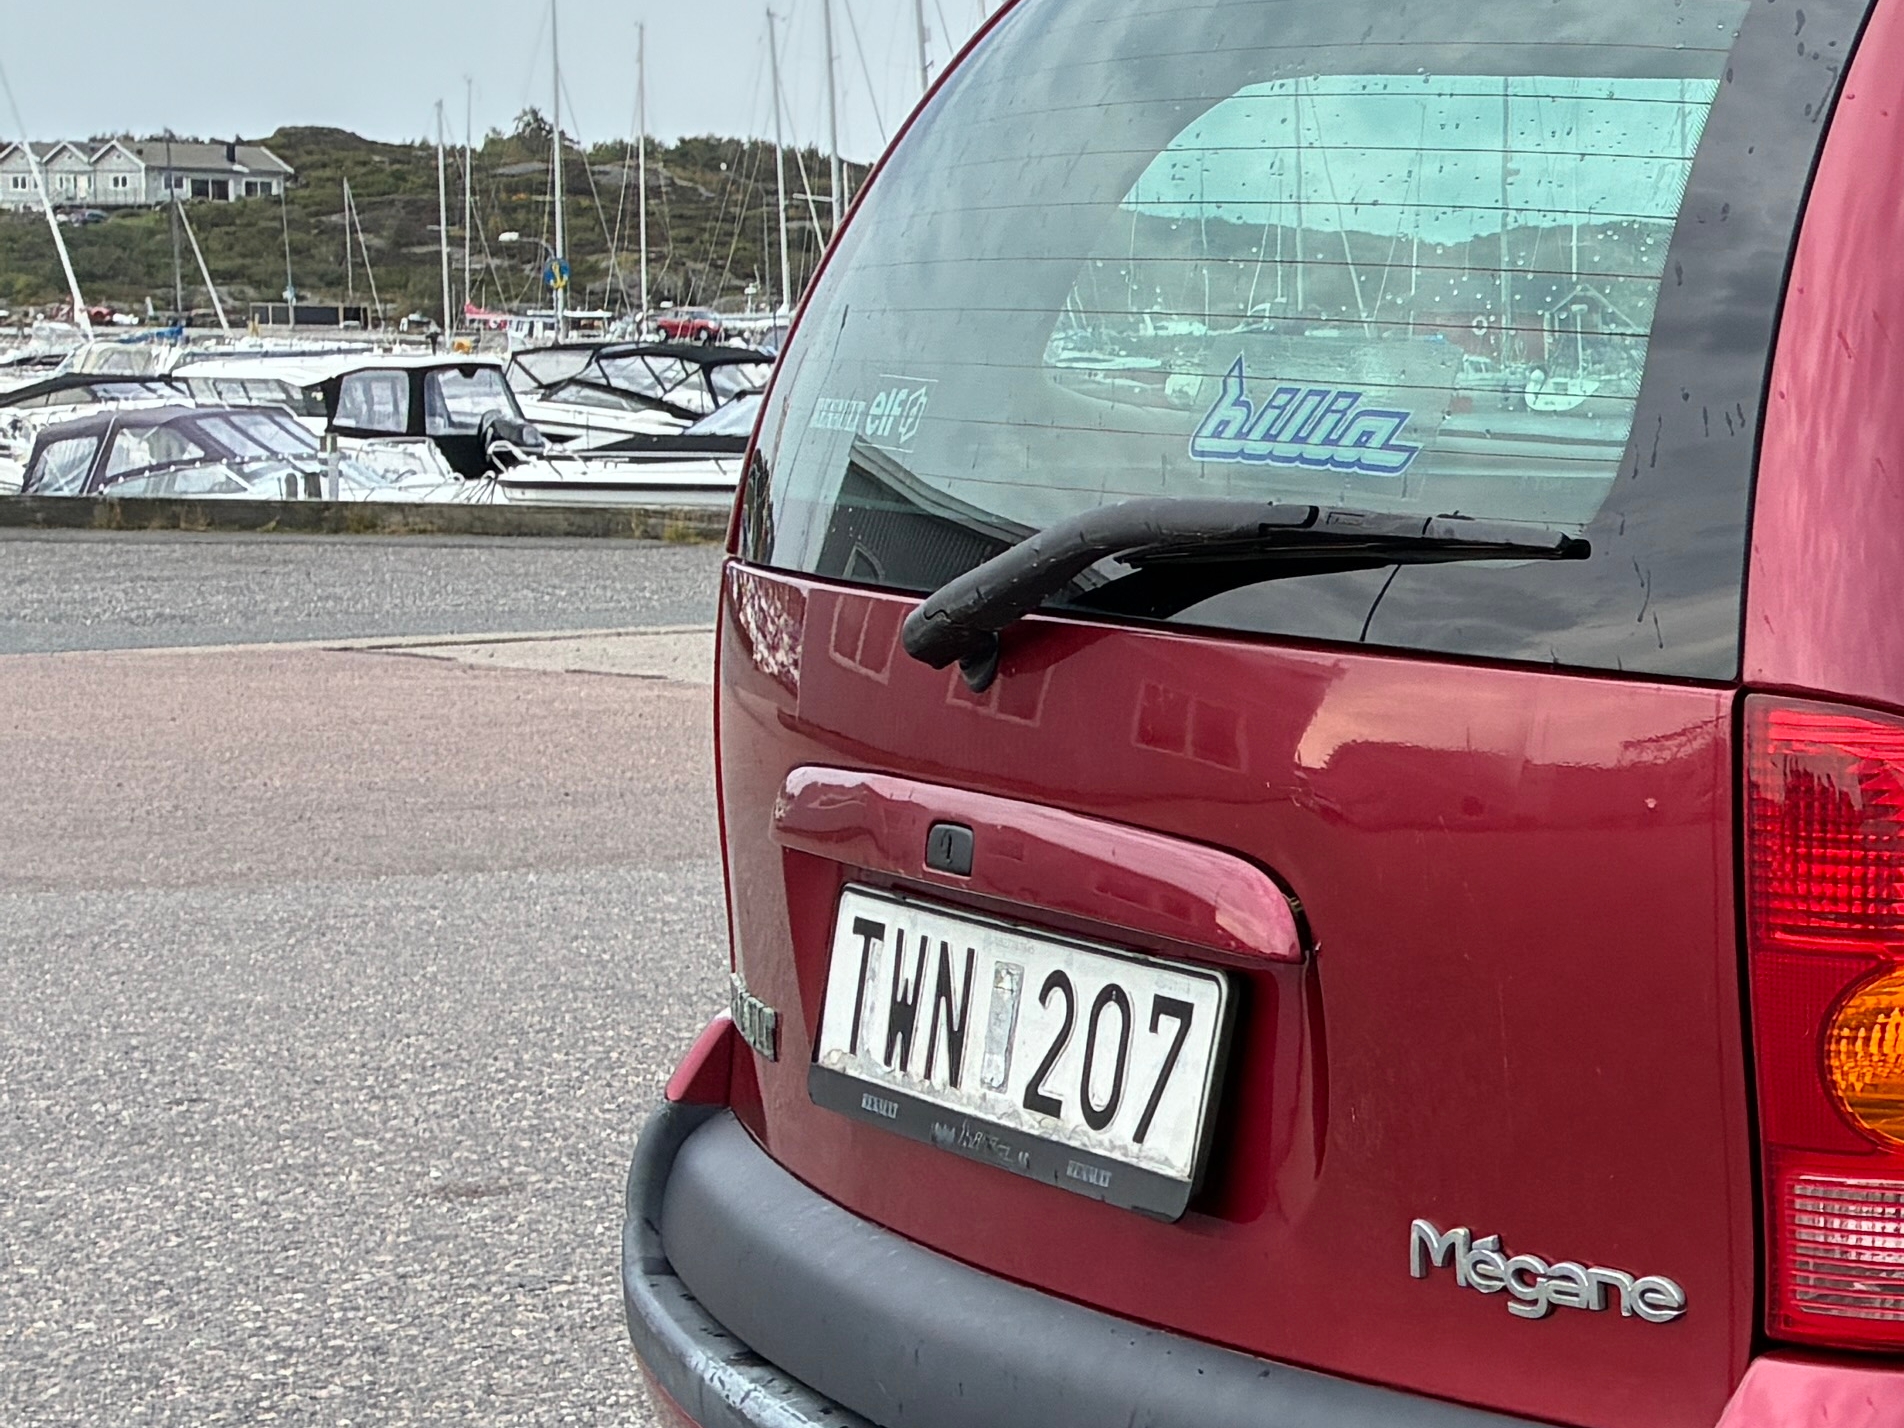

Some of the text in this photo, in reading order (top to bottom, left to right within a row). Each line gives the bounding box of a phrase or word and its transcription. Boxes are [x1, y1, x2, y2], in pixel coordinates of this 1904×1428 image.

[865, 387, 909, 437] elf
[852, 916, 975, 1089] TWN
[1022, 969, 1195, 1144] 207
[1409, 1218, 1688, 1323] Mégane
